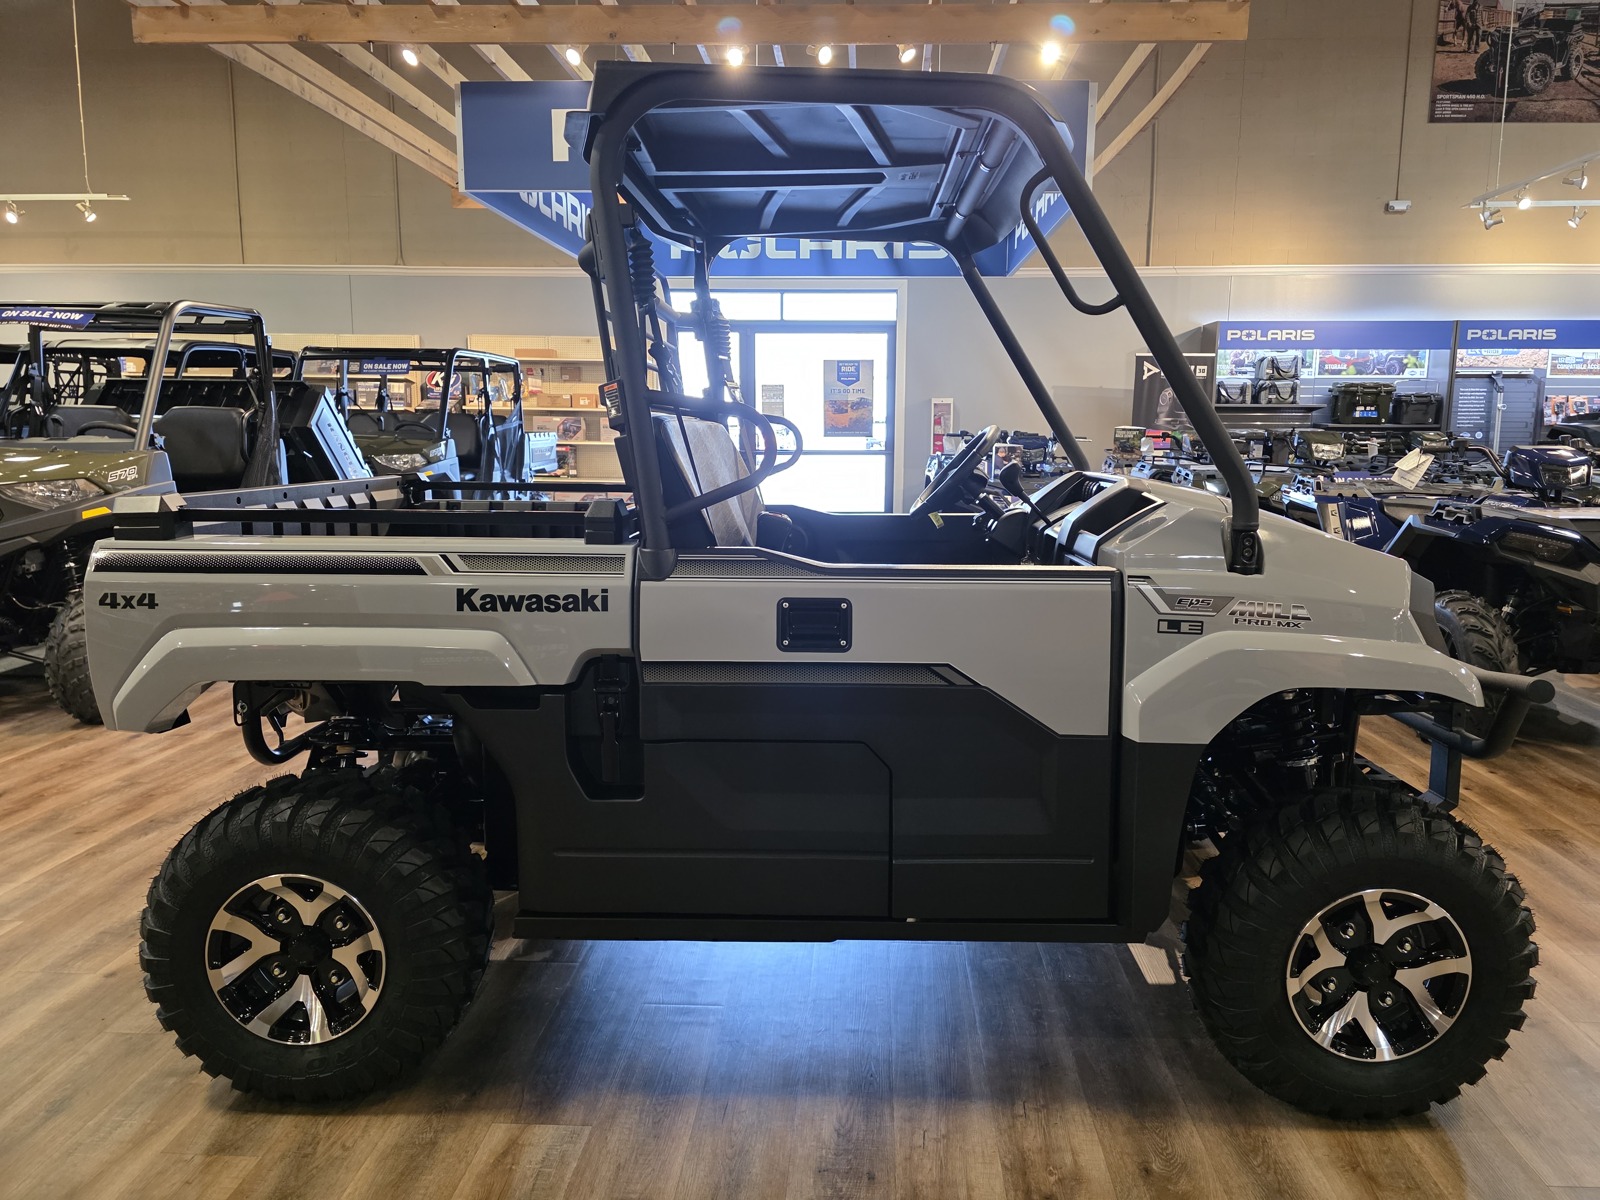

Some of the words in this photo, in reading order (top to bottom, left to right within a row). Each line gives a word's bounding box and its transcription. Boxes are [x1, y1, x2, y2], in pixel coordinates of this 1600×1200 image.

[19, 310, 54, 318] SALE
[51, 311, 84, 320] NOW
[1226, 329, 1315, 341] POLARIS
[1466, 328, 1557, 340] POLARIS
[107, 465, 138, 483] 570
[98, 592, 159, 610] 4x4
[456, 587, 609, 613] Kawasaki
[1226, 600, 1313, 622] MULE
[1157, 620, 1203, 635] LE
[1233, 617, 1305, 630] PRO-MX
